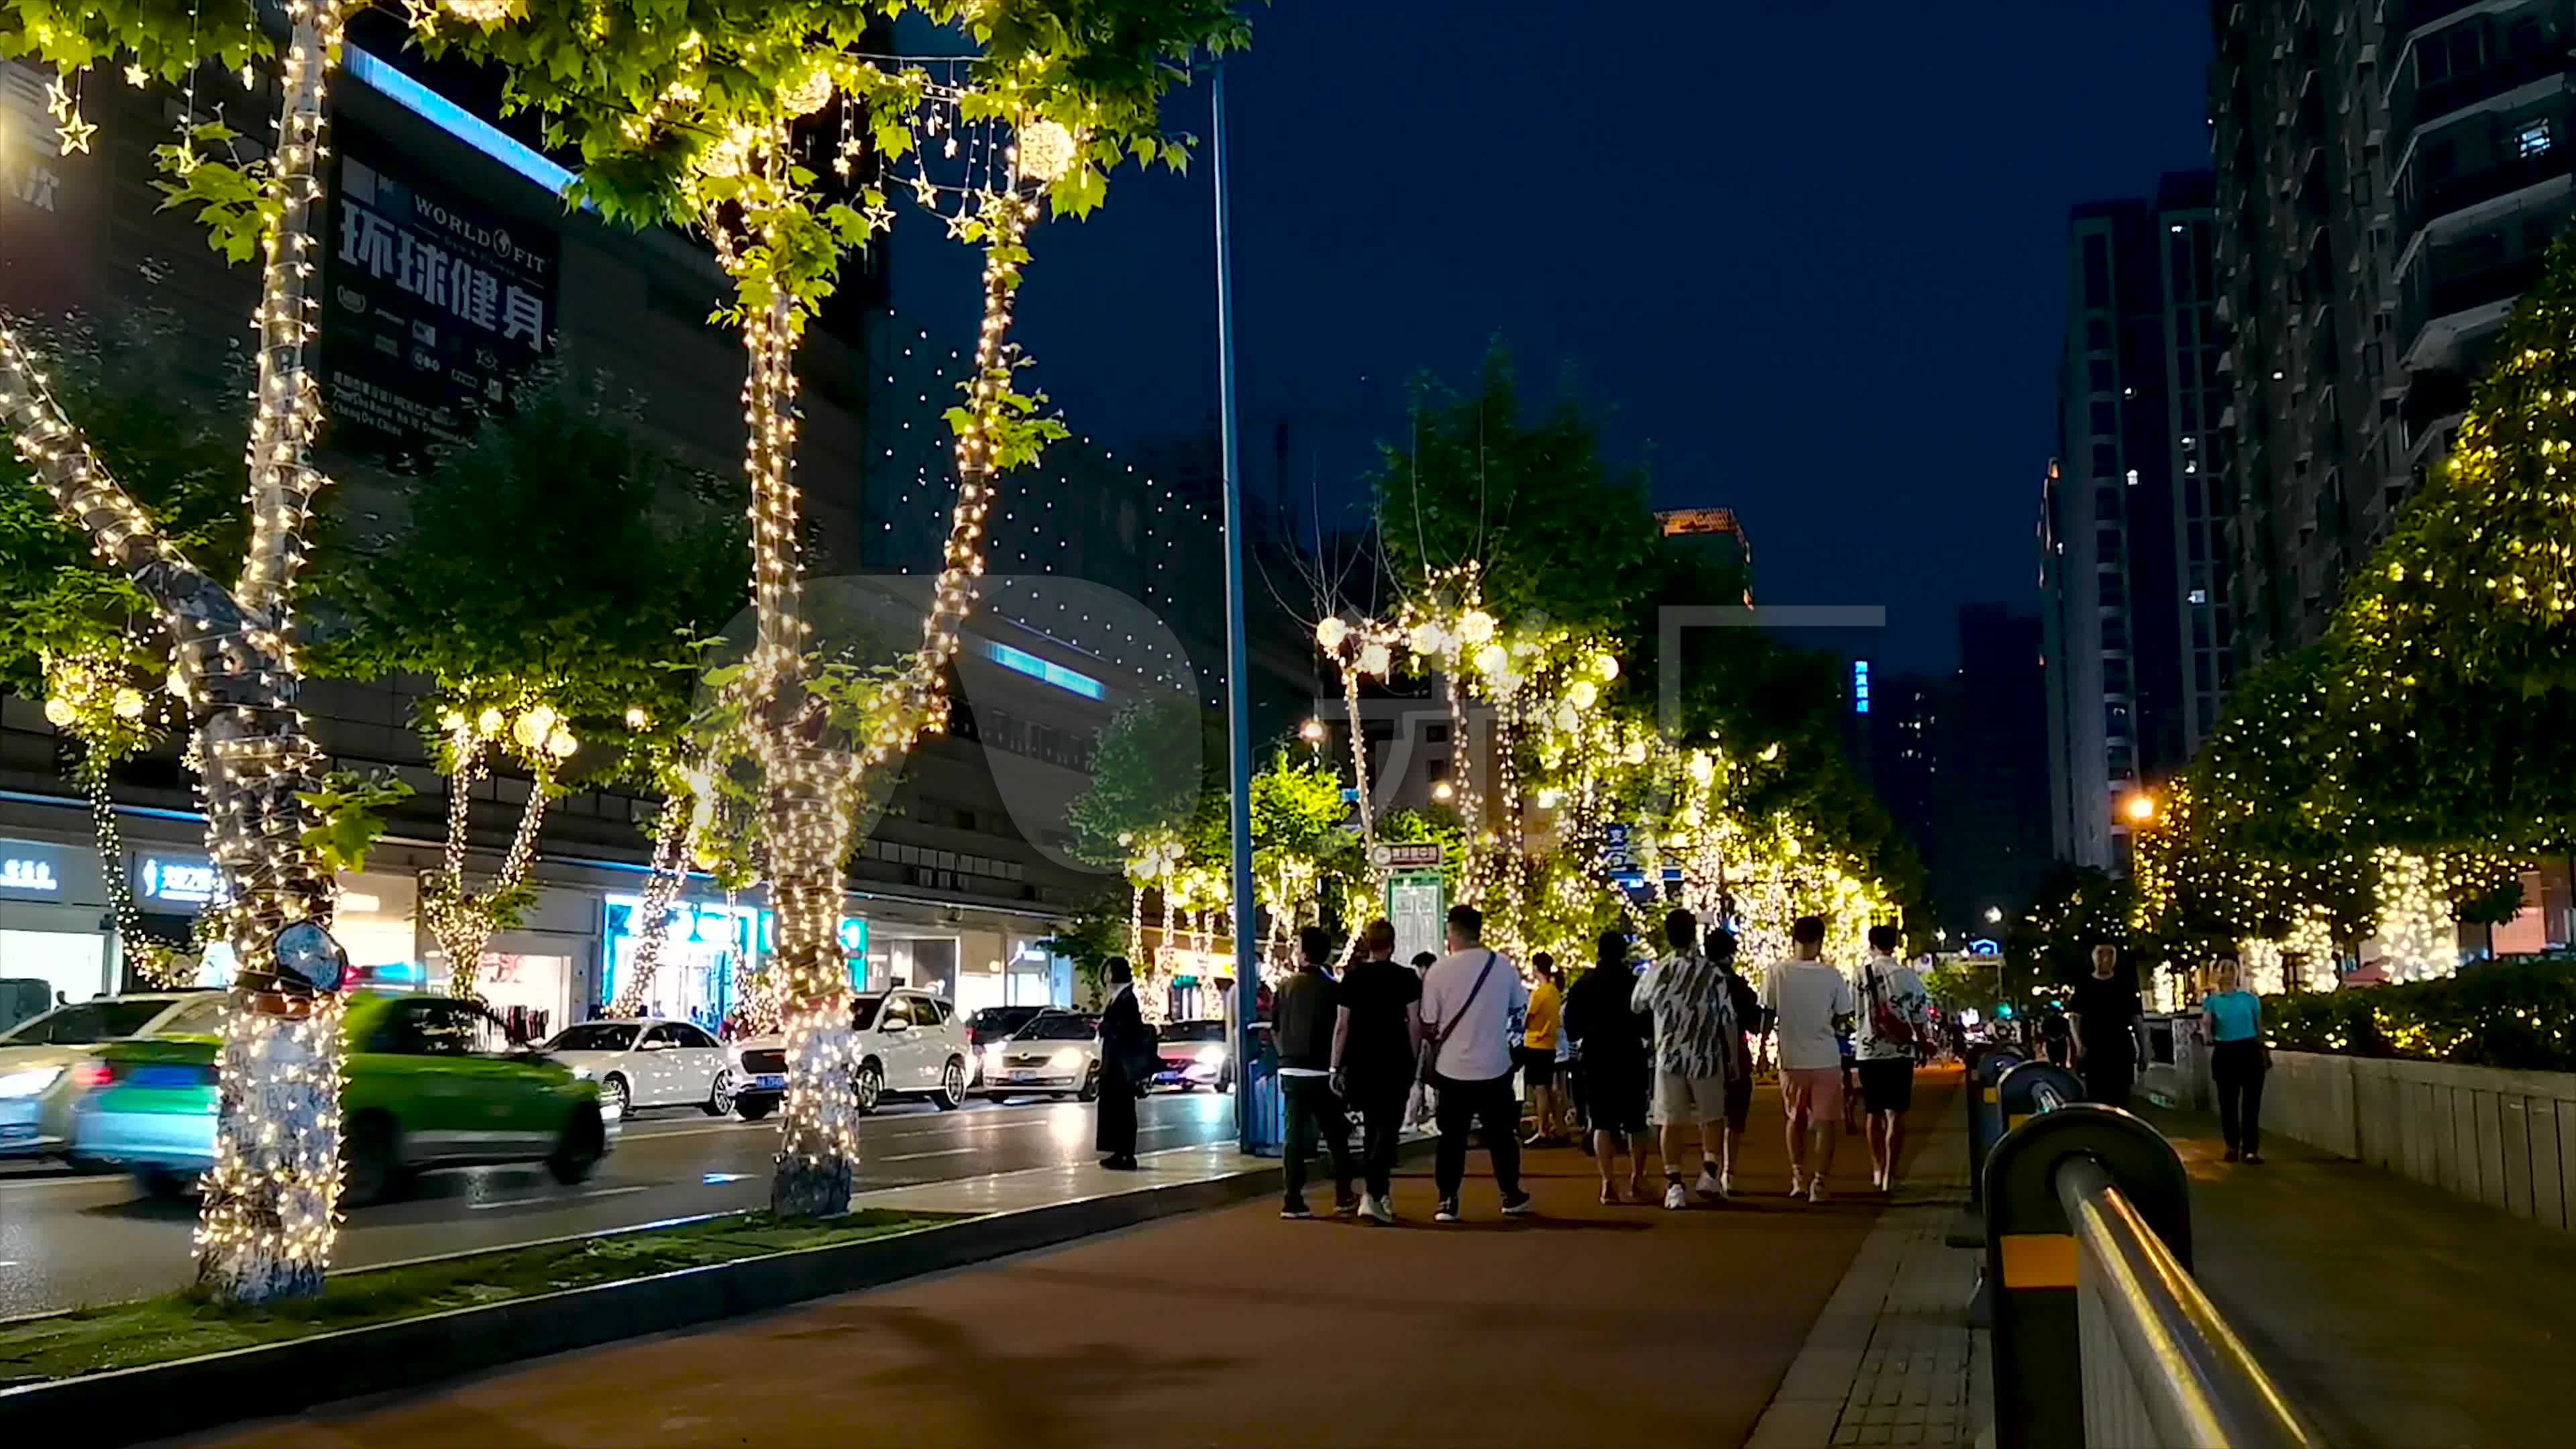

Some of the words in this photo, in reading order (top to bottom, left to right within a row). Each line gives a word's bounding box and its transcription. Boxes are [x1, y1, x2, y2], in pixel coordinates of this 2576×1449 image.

[338, 199, 543, 353] 环球健身
[415, 193, 490, 247] WORLD
[514, 246, 547, 273] FIT
